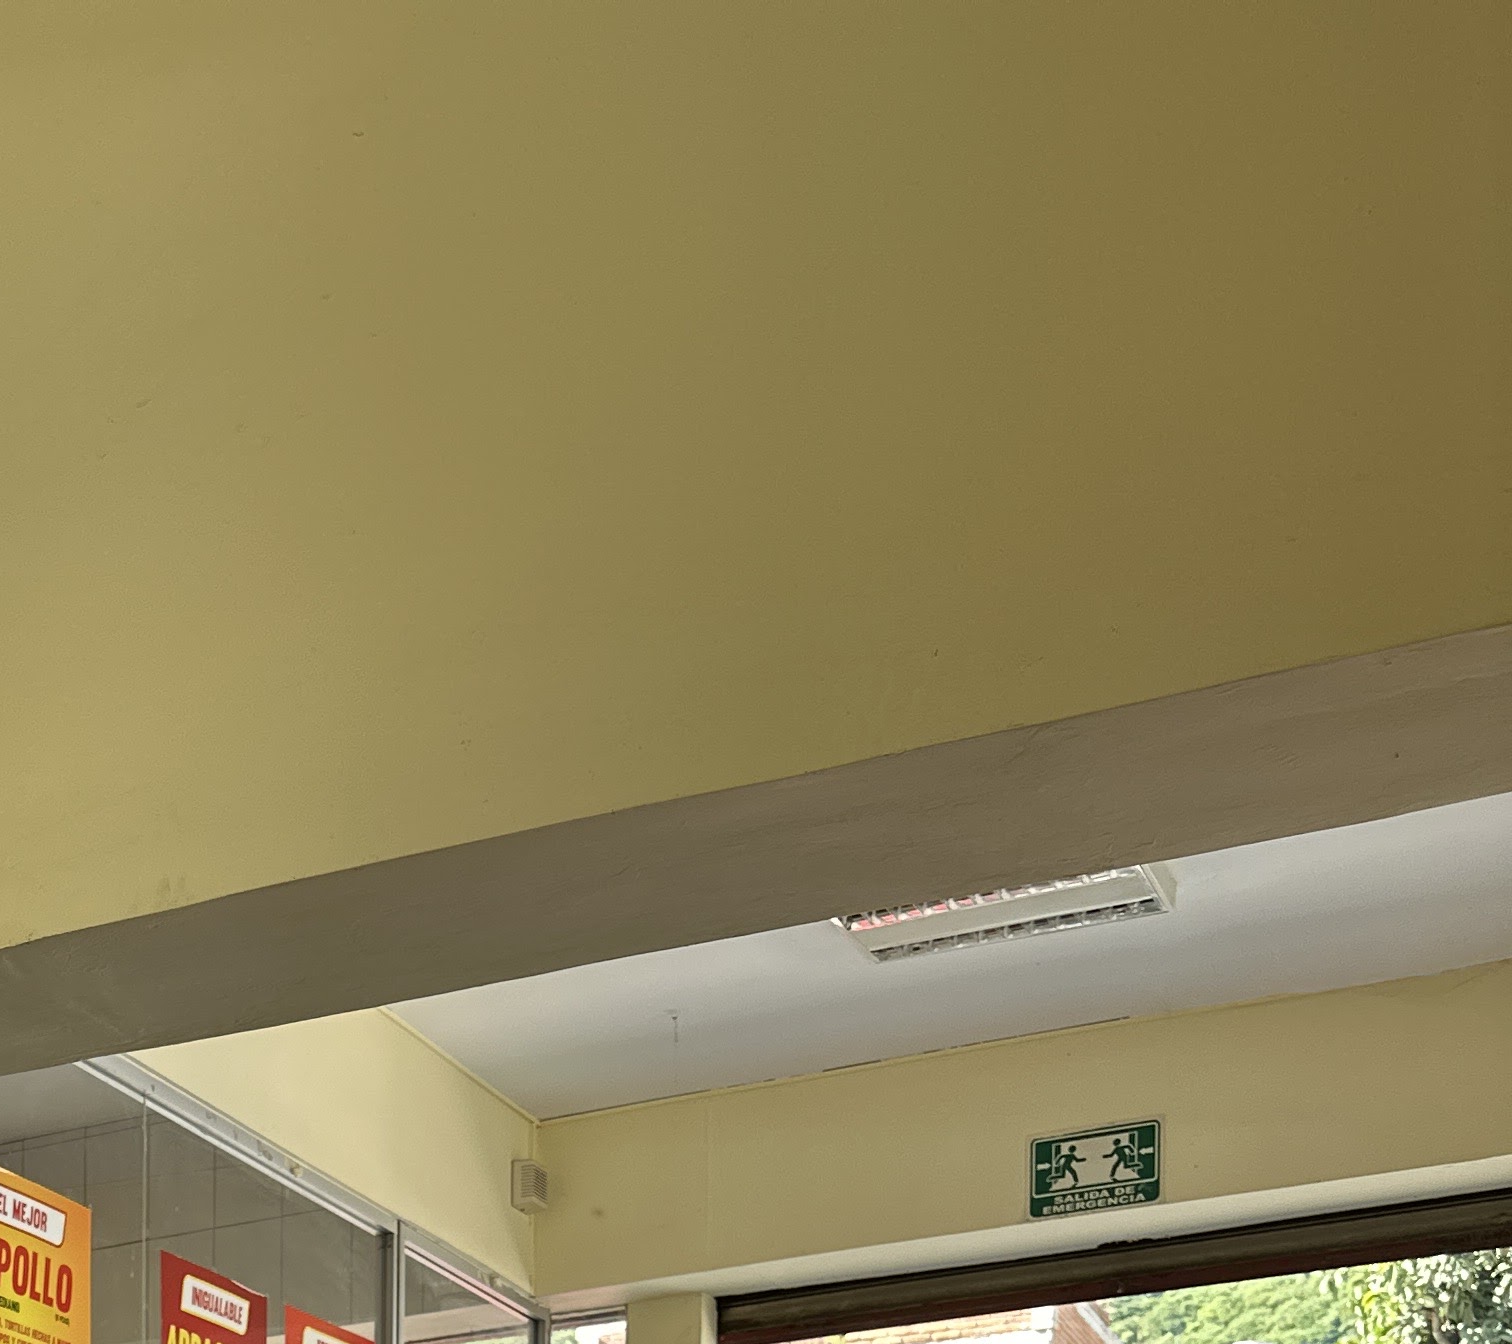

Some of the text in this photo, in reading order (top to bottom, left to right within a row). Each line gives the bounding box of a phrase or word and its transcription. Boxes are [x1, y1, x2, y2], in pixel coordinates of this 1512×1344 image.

[1042, 1193, 1146, 1215] EMERGENCIA
[1054, 1185, 1136, 1205] SALIDA DE
[12, 1198, 48, 1233] MEJOR
[191, 1285, 244, 1326] INIGUALABLE
